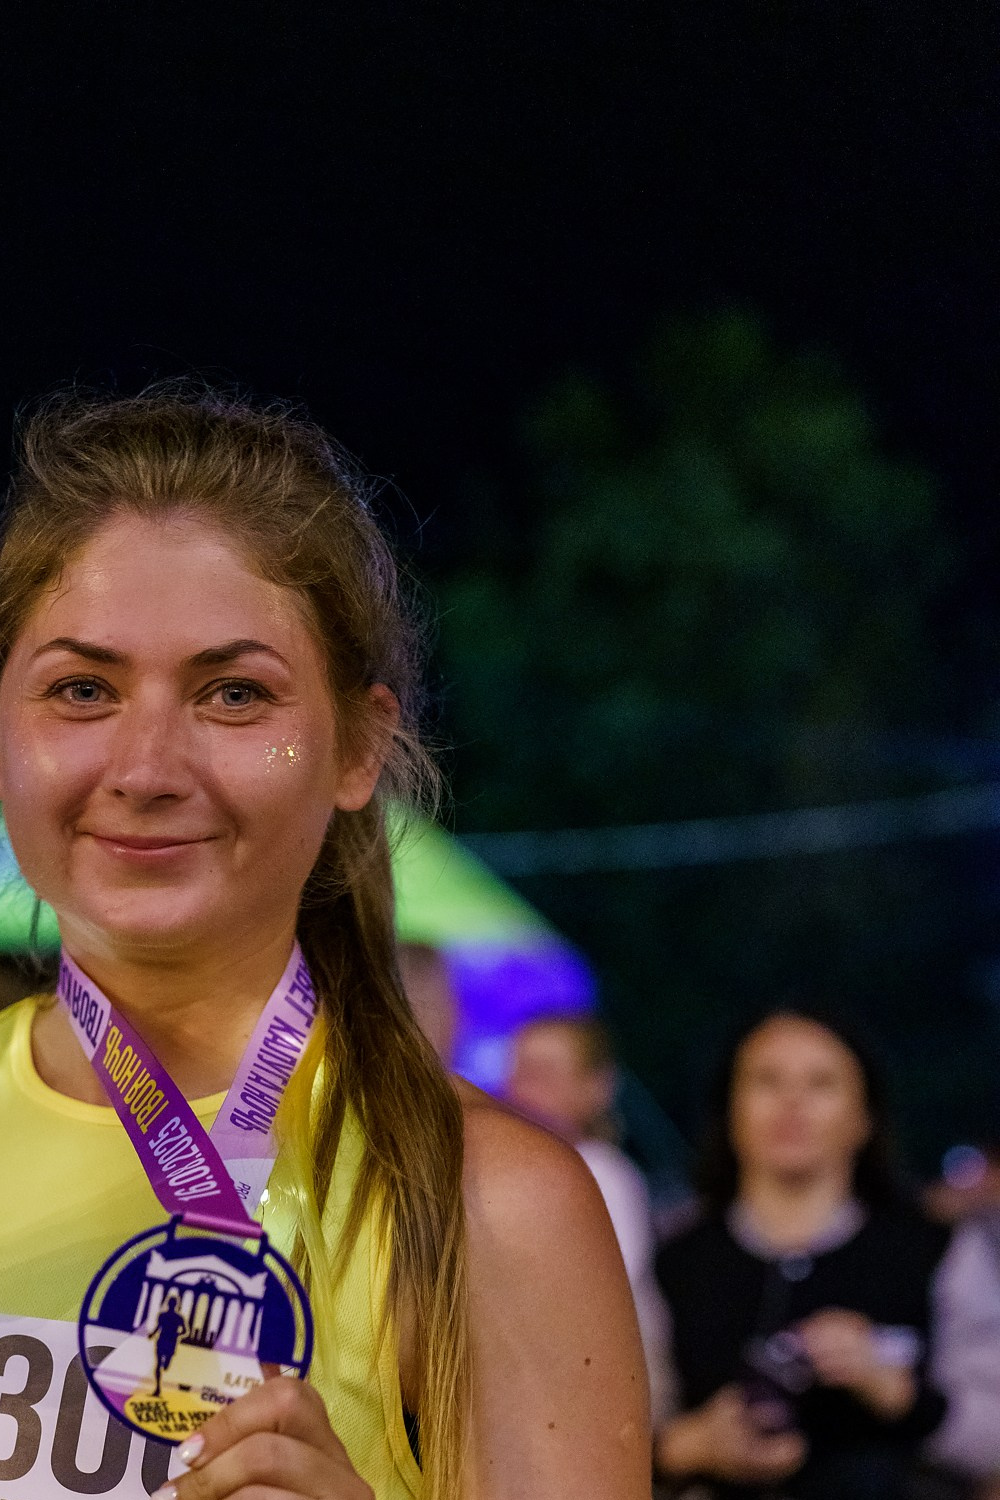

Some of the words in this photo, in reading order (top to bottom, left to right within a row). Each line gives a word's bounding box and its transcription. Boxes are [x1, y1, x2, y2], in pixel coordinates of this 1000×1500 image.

[254, 1015, 308, 1092] КАЛУГА
[124, 1069, 169, 1135] ТВОЯ
[229, 1079, 281, 1135] НОЧЬ
[148, 1116, 222, 1202] 16.08.2025
[201, 1391, 235, 1406] СПОР
